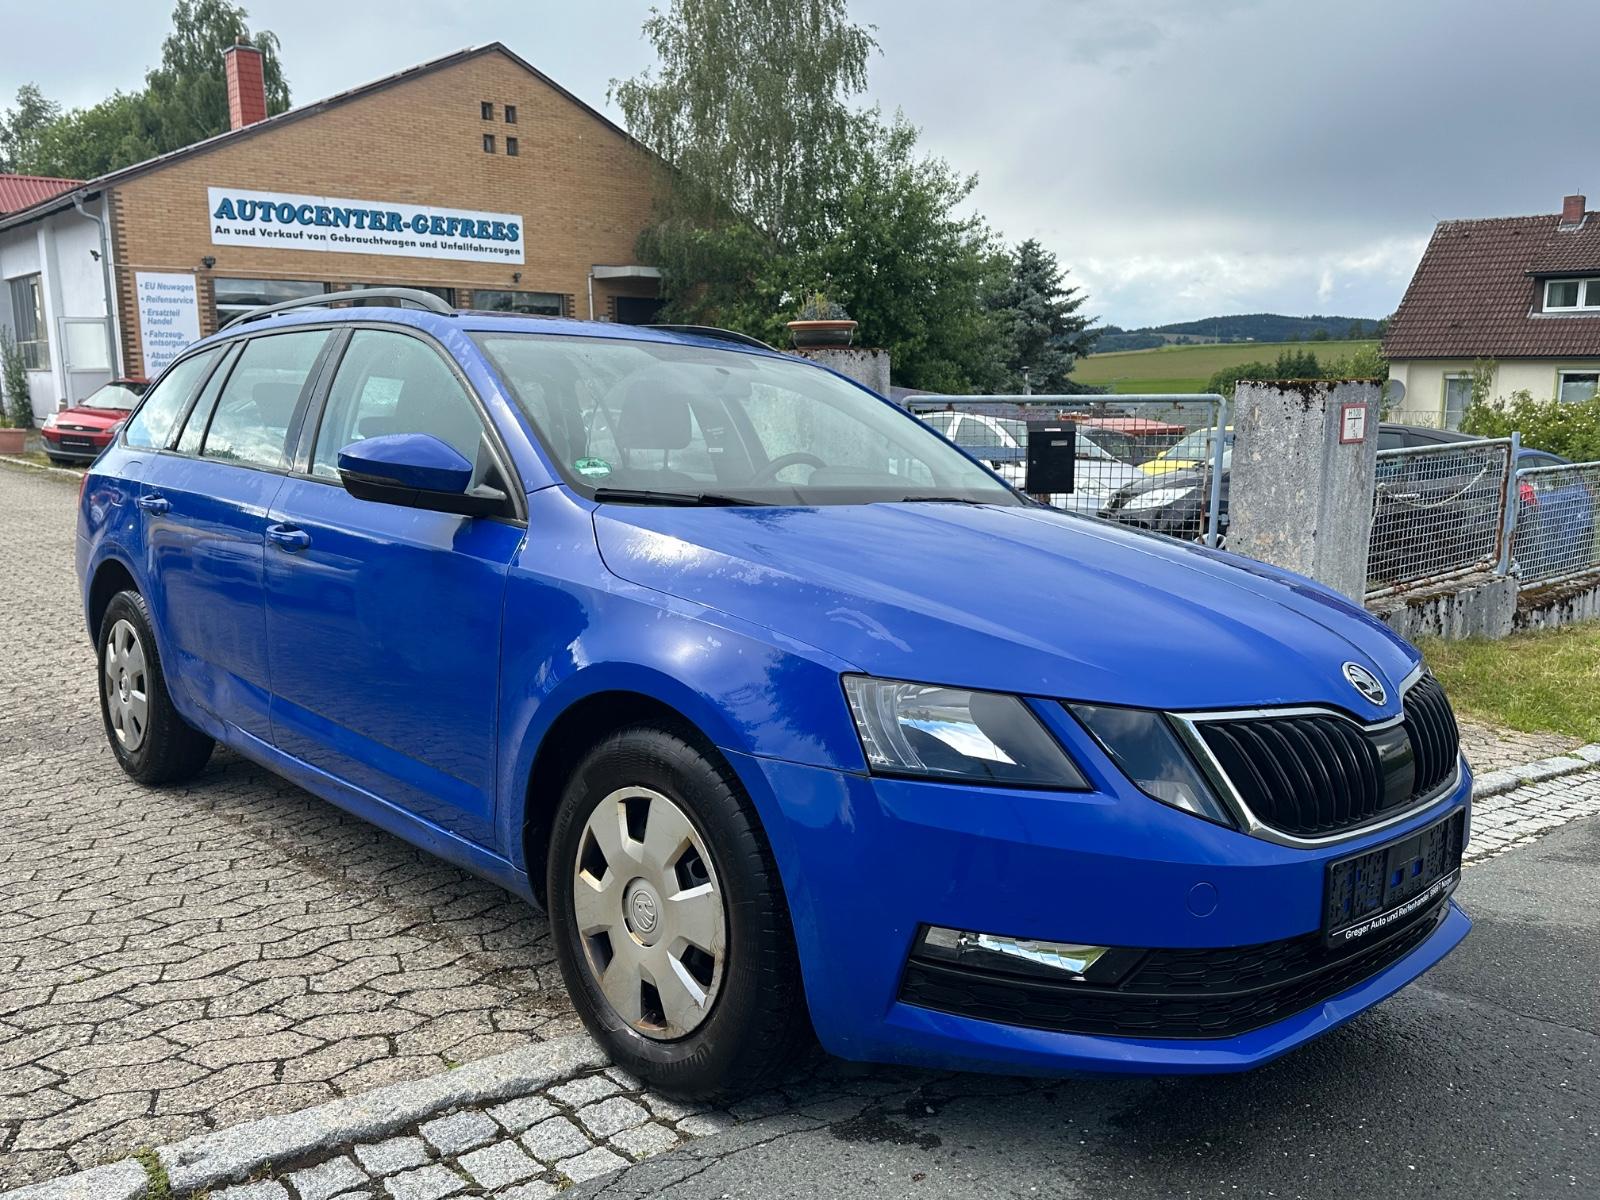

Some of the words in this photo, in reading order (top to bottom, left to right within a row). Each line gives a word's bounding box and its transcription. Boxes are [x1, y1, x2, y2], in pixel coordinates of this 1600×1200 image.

[213, 197, 519, 242] AUTOCENTER-GEFREES
[215, 225, 230, 234] An
[234, 227, 256, 236] und
[260, 228, 304, 239] Verkauf
[307, 233, 327, 241] von
[330, 233, 416, 248] Gebrauchtwagen
[419, 240, 438, 249] und
[441, 242, 521, 256] Unfallfahrzeugen
[144, 281, 156, 290] EU
[157, 282, 194, 292] Neuwagen
[146, 296, 194, 304] Reifenservice
[147, 308, 181, 317] Ersatzteil
[147, 317, 172, 325] Handel
[149, 330, 184, 339] Fahrzeug-
[1345, 925, 1370, 939] Greger
[1371, 917, 1386, 930] Auto
[1387, 910, 1398, 922] und
